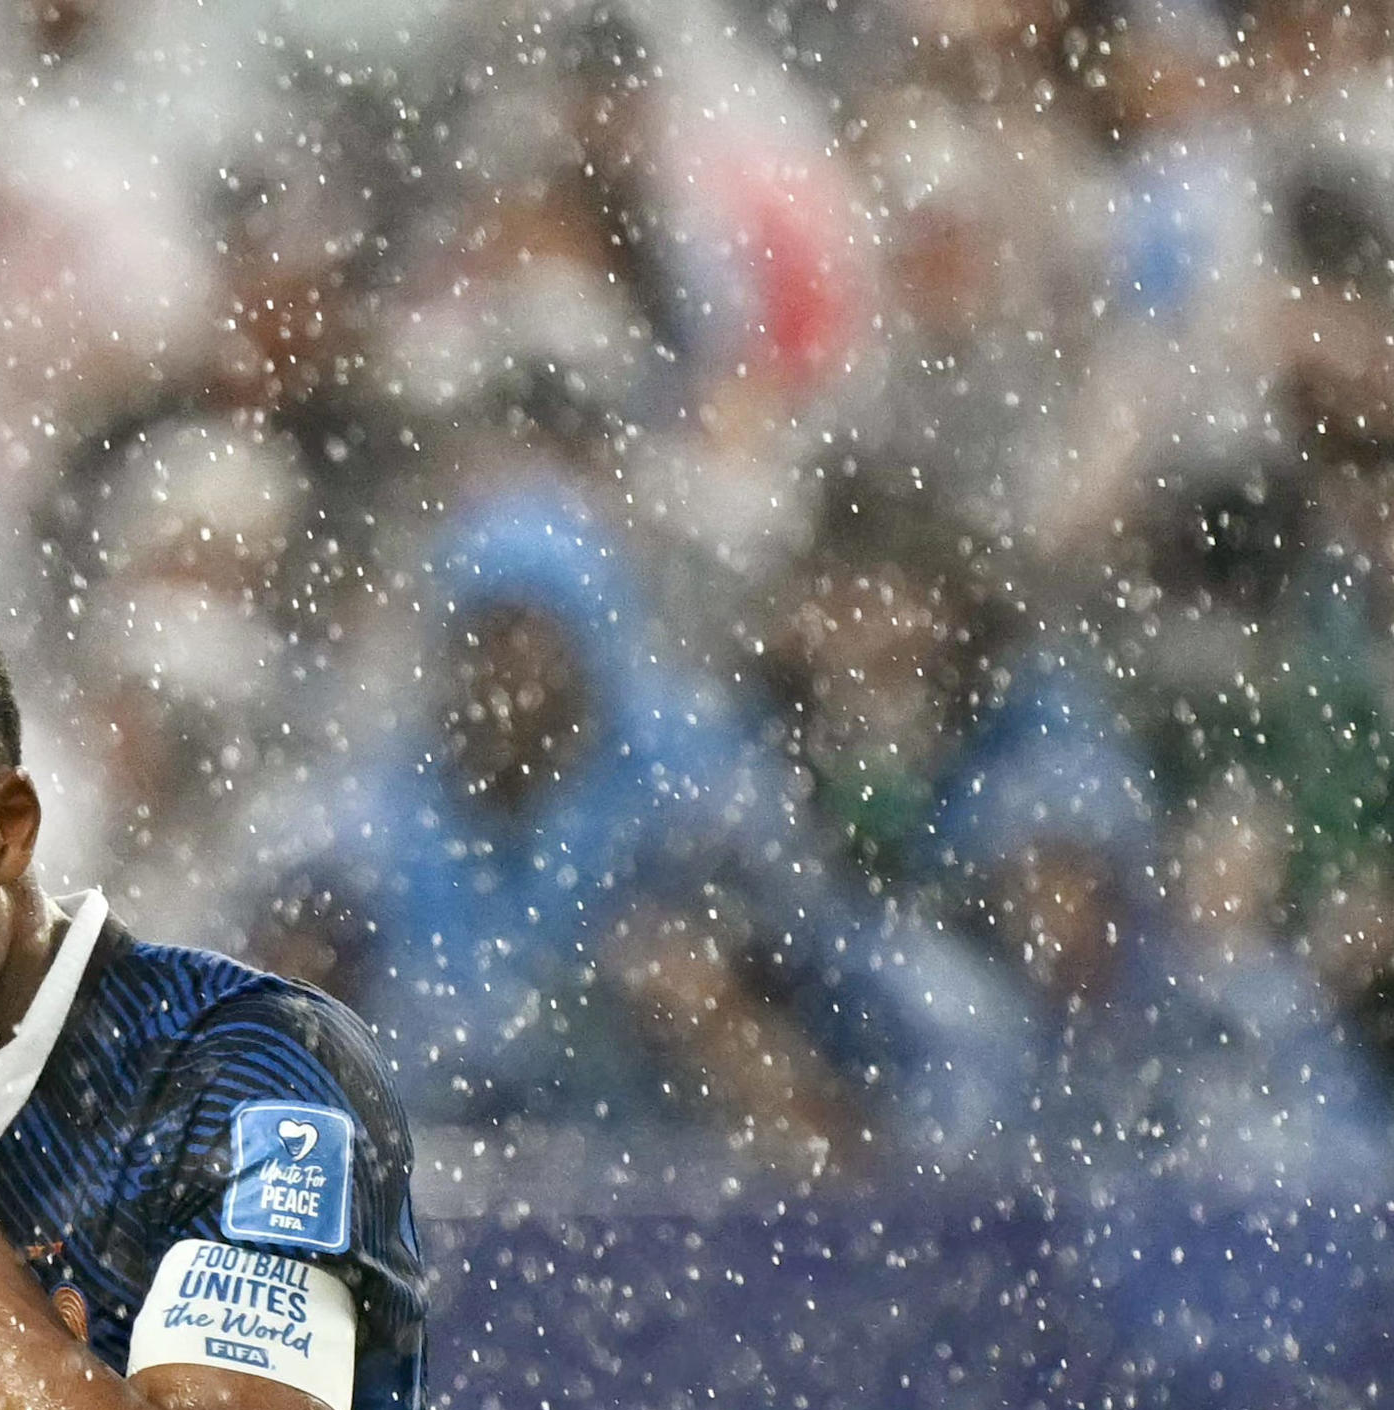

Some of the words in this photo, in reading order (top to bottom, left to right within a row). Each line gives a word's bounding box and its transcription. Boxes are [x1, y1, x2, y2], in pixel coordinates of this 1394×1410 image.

[260, 1157, 303, 1185] Unite
[304, 1165, 327, 1189] For
[261, 1184, 321, 1217] PEACE
[269, 1213, 305, 1231] FIFA
[191, 1245, 310, 1292] FOOTBALL
[178, 1270, 307, 1323] UNITES
[162, 1302, 215, 1328] the
[221, 1307, 313, 1359] World
[209, 1340, 267, 1365] FIFA
